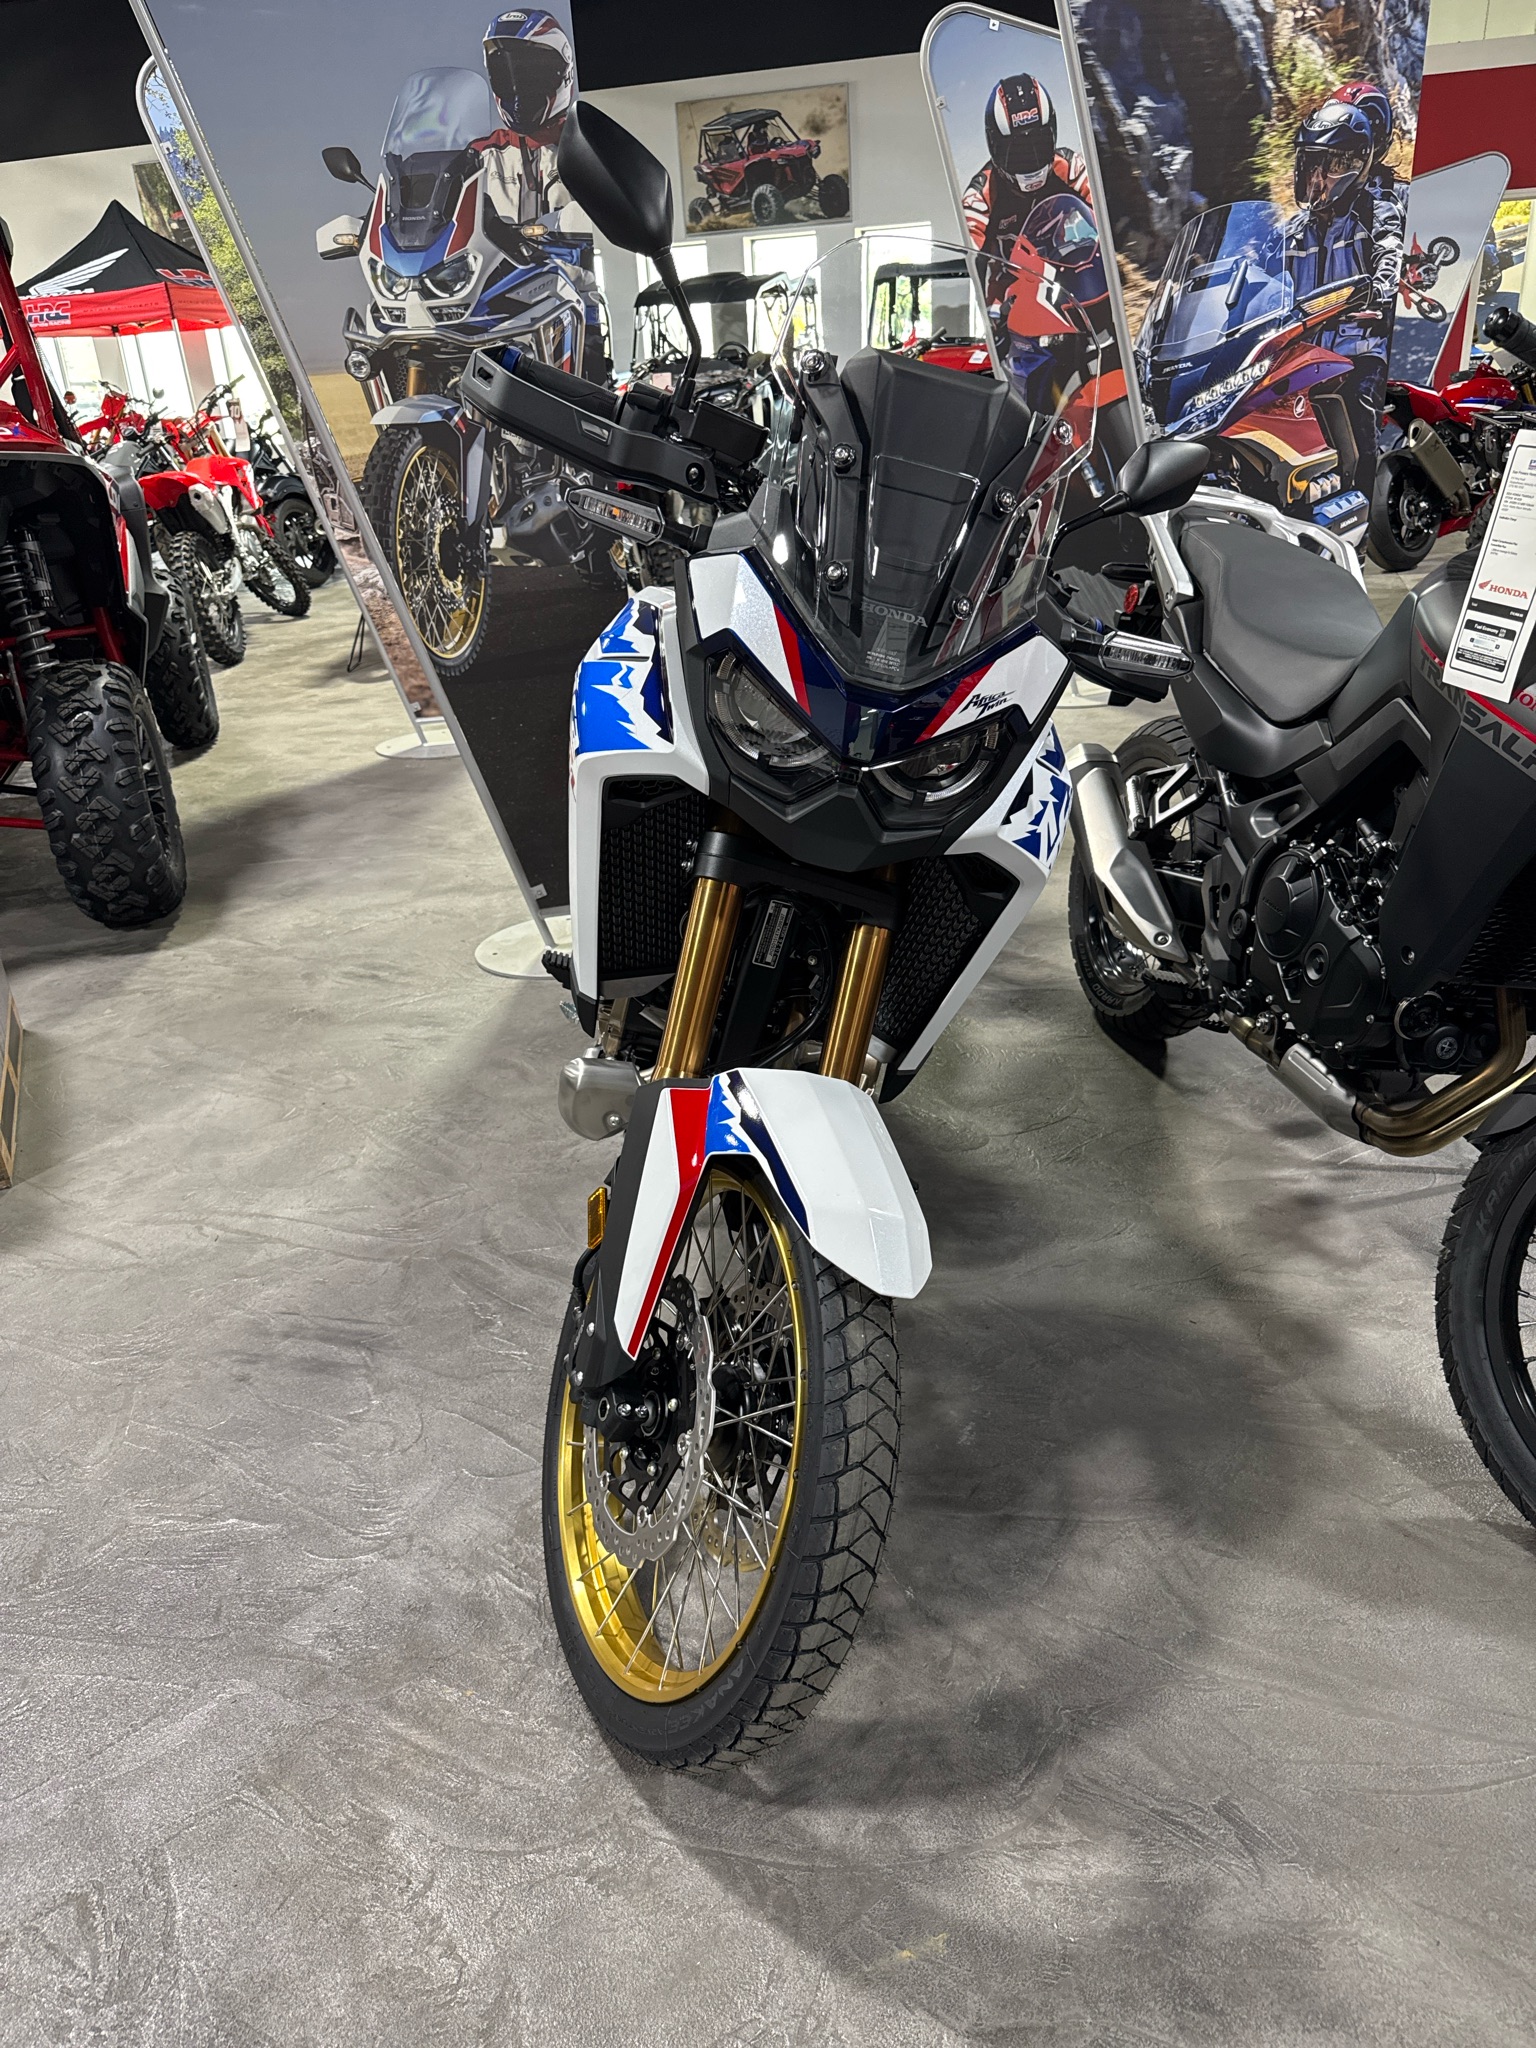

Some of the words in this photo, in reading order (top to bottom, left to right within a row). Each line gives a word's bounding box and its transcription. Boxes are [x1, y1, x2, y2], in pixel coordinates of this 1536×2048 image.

[1011, 107, 1040, 127] HRC
[26, 301, 71, 324] HRC
[1488, 584, 1528, 599] HONDA
[860, 602, 928, 628] HONDA
[958, 690, 1016, 715] Africa
[975, 698, 1013, 720] Twin
[1091, 982, 1121, 1006] KAROO
[668, 1658, 744, 1735] ANAKEE
